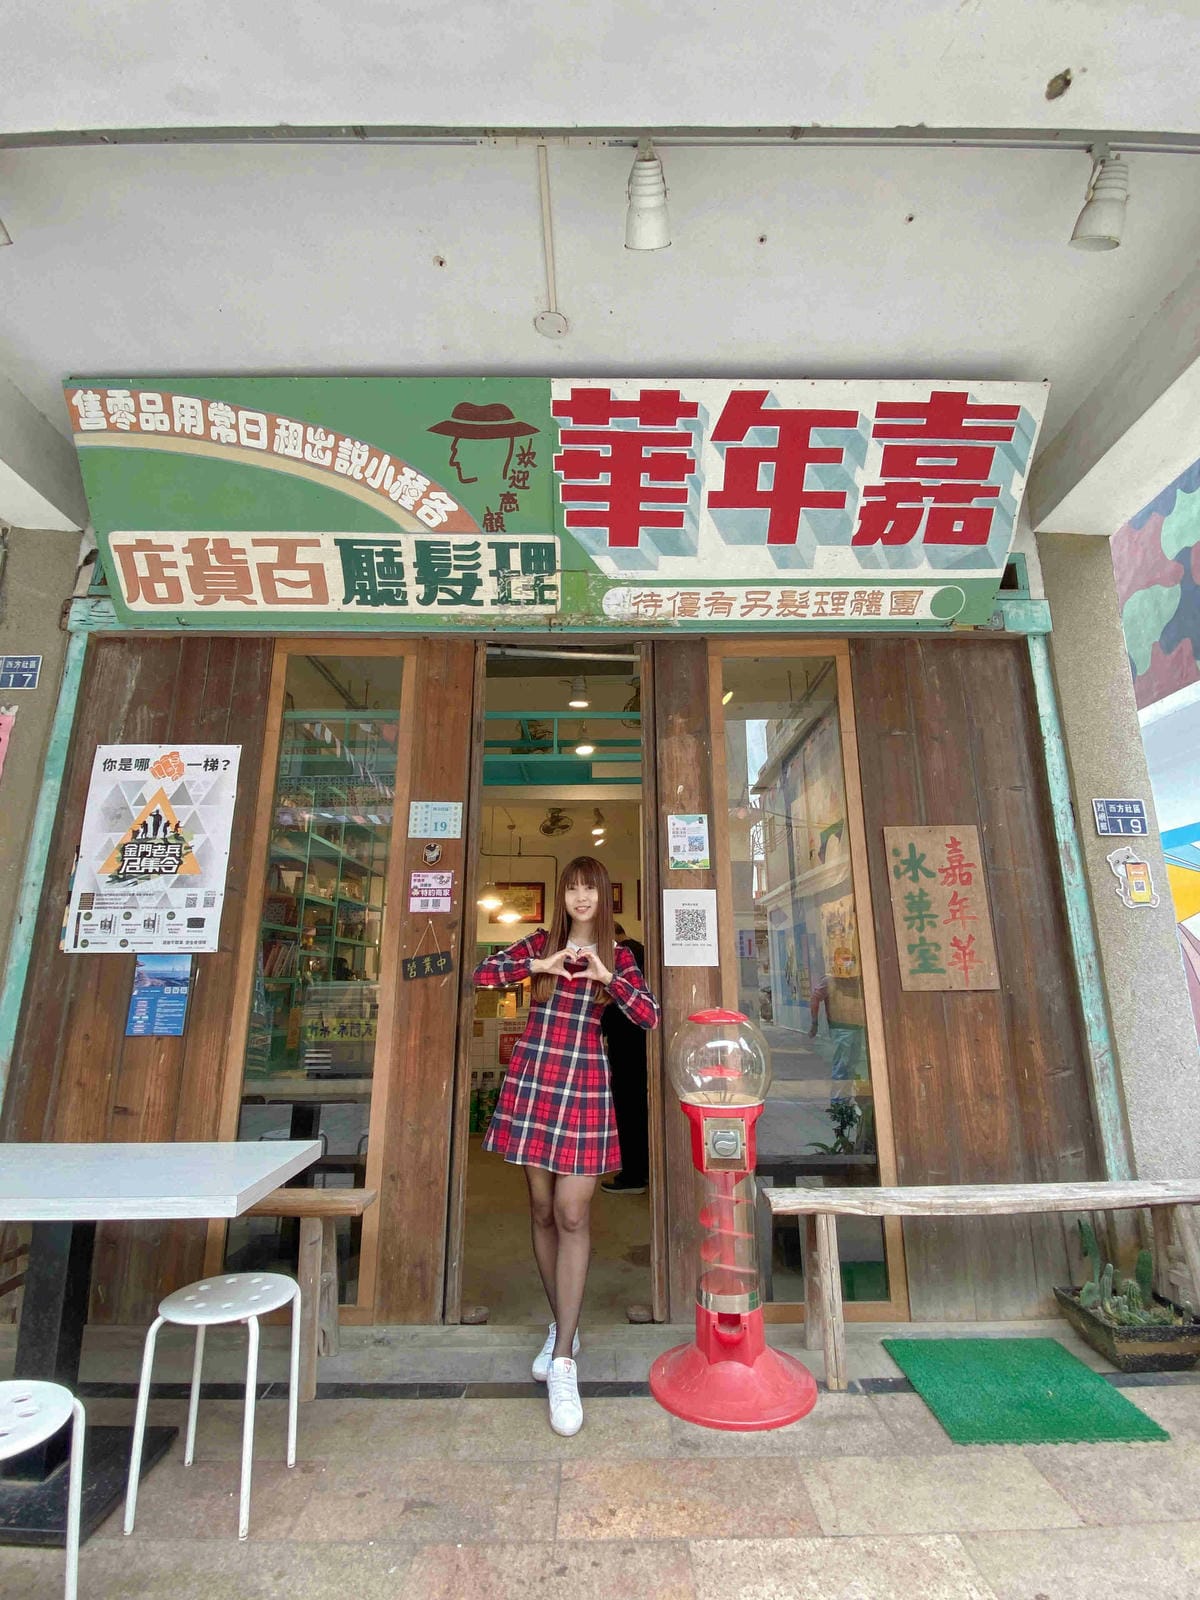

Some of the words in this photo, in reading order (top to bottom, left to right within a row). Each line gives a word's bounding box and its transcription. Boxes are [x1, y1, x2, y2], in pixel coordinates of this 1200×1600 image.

[9, 674, 33, 687] 17
[102, 757, 150, 772] 你是哪
[1108, 803, 1141, 814] 西方社區
[434, 821, 447, 832] 19
[1116, 818, 1142, 834] 19
[124, 844, 181, 857] 金門老兵
[421, 889, 450, 897] 特約商家
[893, 843, 946, 974] 冰菓室
[938, 837, 983, 986] 嘉年華
[407, 956, 446, 978] 營業中
